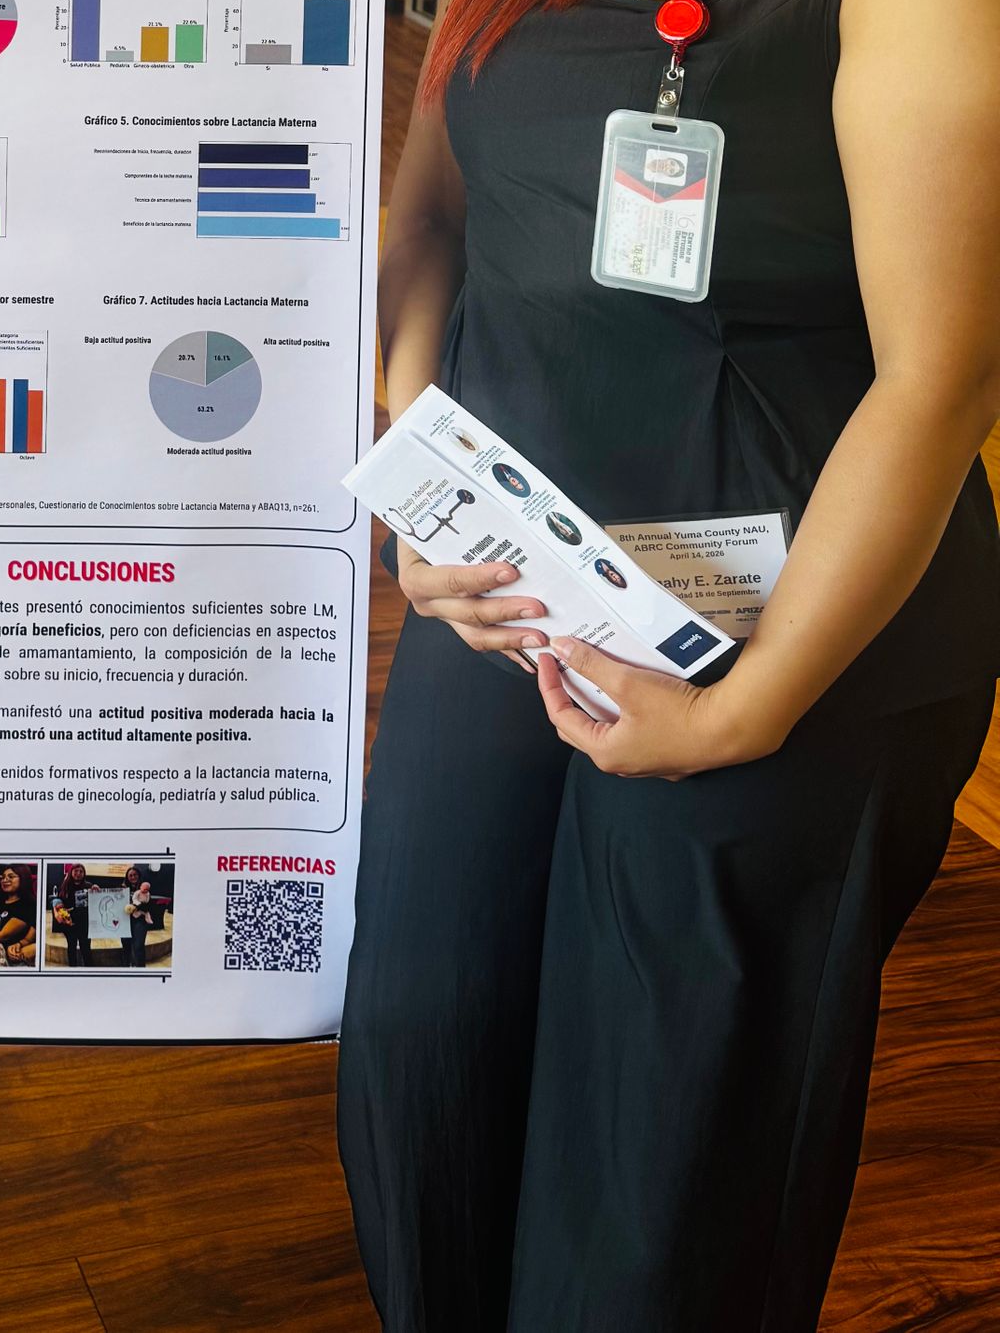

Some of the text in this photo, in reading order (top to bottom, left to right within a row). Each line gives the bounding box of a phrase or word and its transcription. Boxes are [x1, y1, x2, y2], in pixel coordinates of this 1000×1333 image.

[84, 335, 151, 345] Baja actitud positiva
[619, 524, 769, 542] 8th Annual Yuma County NAU,
[634, 538, 758, 552] ABRC Community Forum
[669, 549, 725, 560] April 14, 2026
[7, 559, 175, 583] CONCLUSIONES
[694, 573, 761, 586] E. Zarate
[25, 599, 83, 616] presentó
[89, 600, 185, 614] conocimientos
[191, 600, 263, 614] suficientes
[269, 600, 306, 615] sobre
[313, 602, 337, 619] LM,
[216, 855, 336, 875] REFERENCIAS
